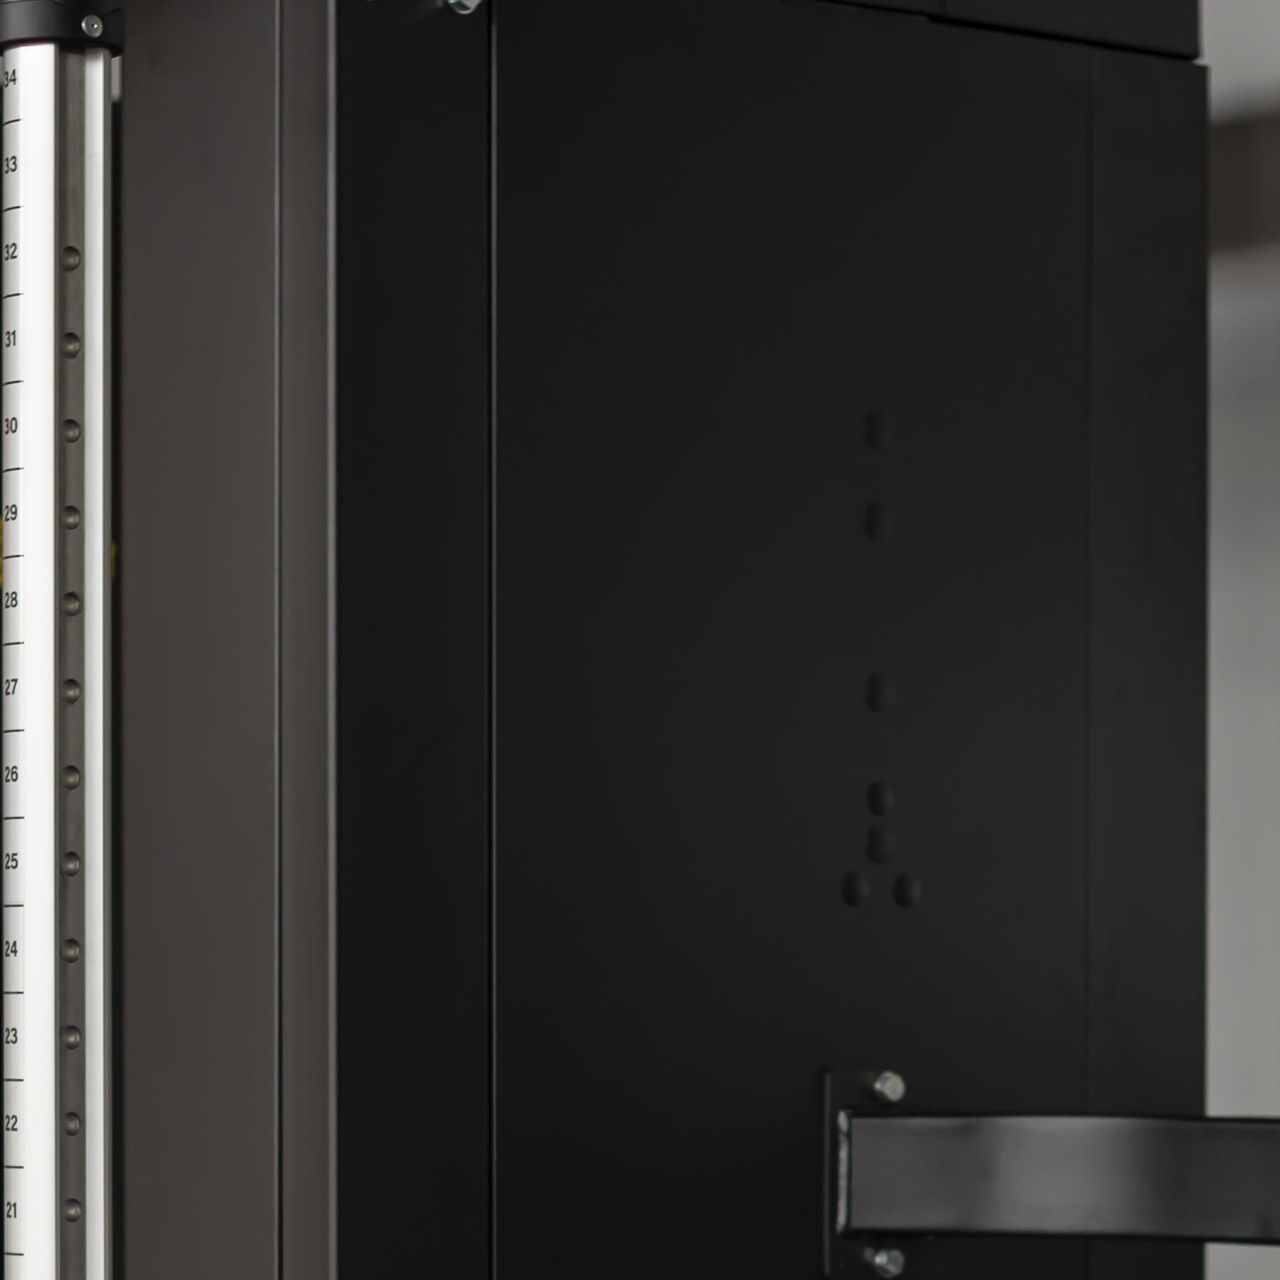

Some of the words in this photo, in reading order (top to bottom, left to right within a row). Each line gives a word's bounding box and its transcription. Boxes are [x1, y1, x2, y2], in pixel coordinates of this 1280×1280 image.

[3, 69, 17, 87] 34
[3, 156, 17, 174] 33
[3, 243, 17, 261] 32
[5, 330, 17, 347] 31
[4, 417, 18, 434] 30
[4, 505, 18, 522] 29
[4, 592, 18, 609] 28
[4, 679, 18, 696] 27
[4, 765, 18, 783] 26
[5, 853, 18, 869] 25
[5, 940, 18, 957] 24
[5, 1027, 18, 1044] 23
[5, 1114, 18, 1131] 22
[6, 1201, 17, 1218] 21
